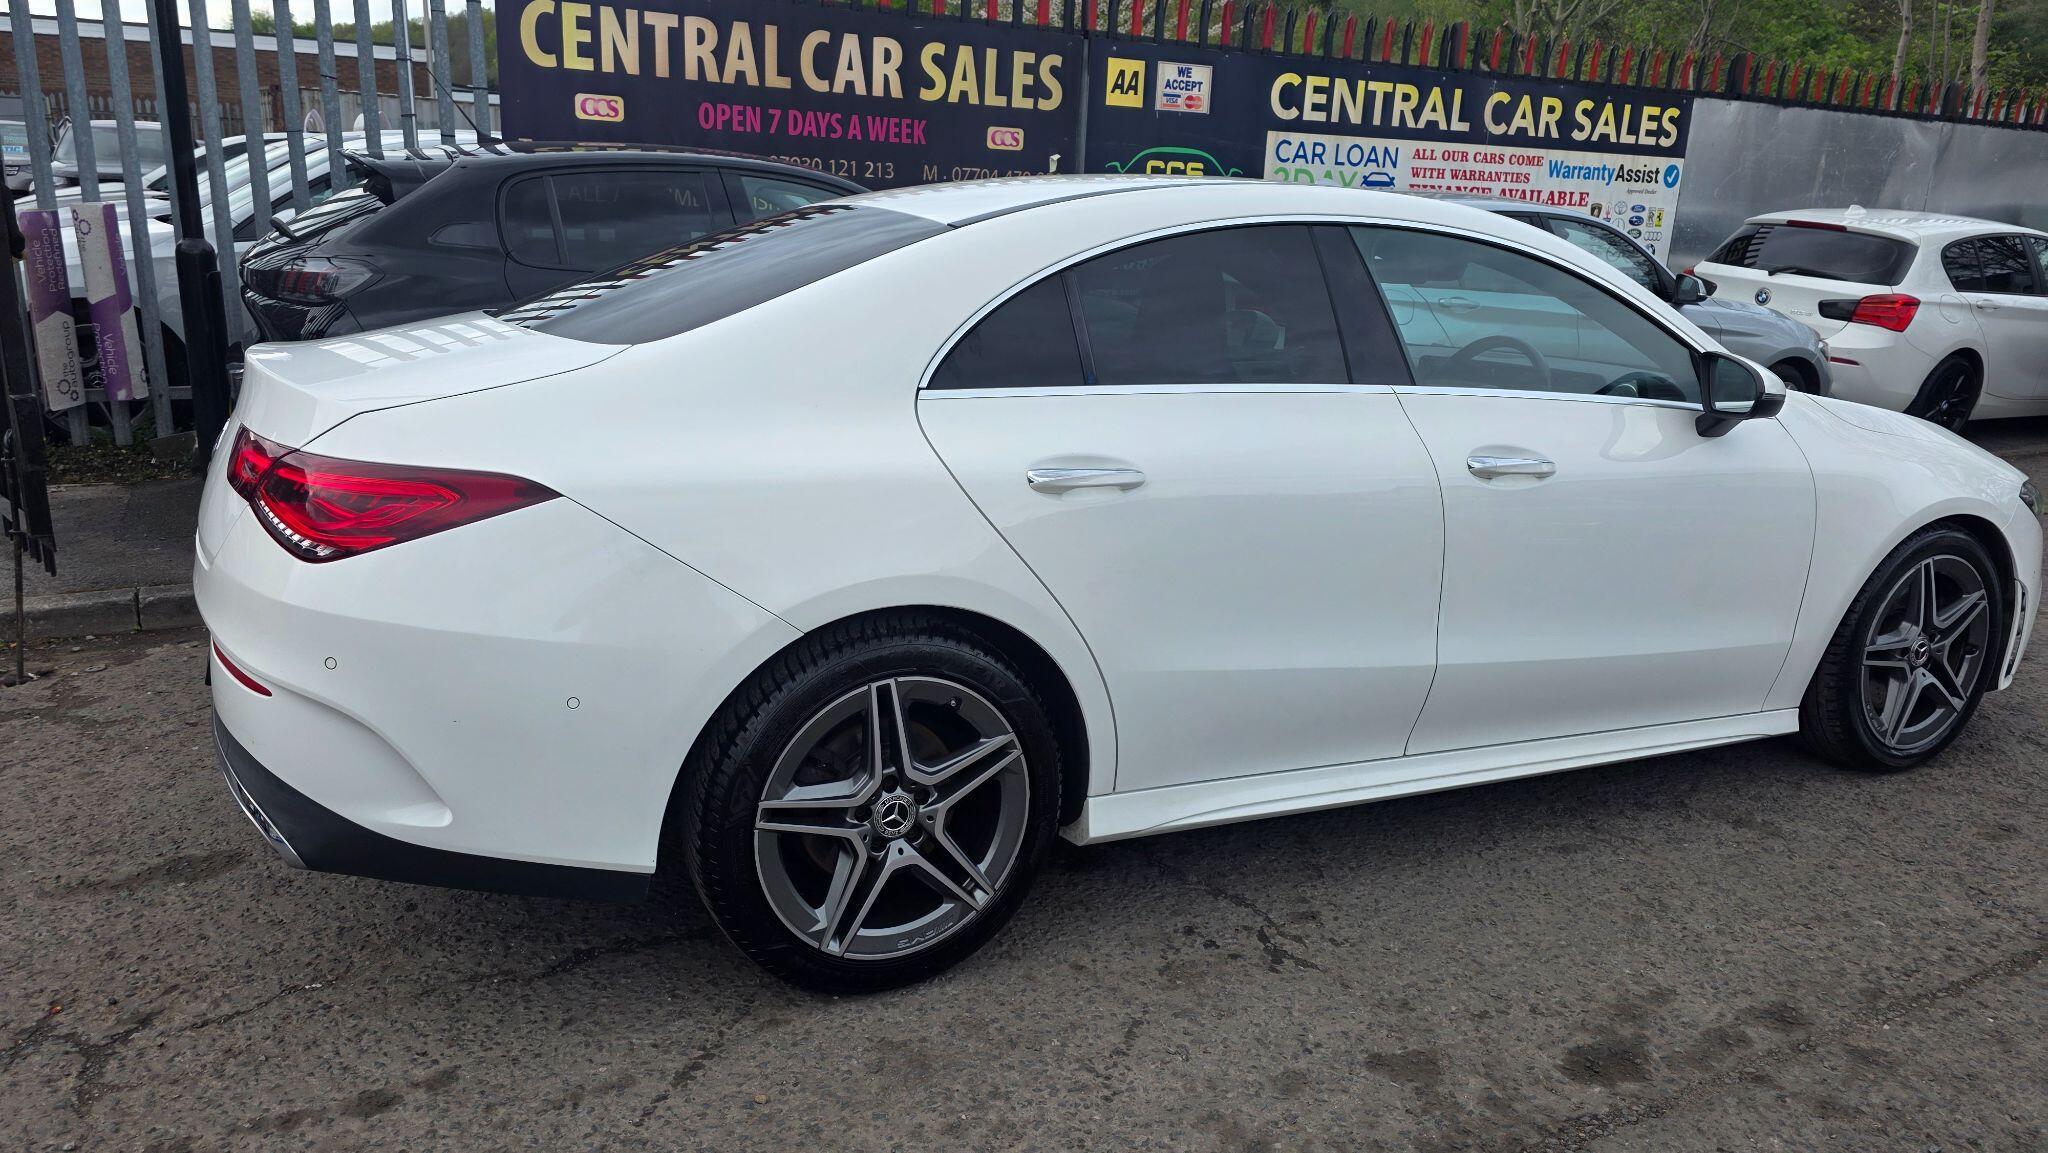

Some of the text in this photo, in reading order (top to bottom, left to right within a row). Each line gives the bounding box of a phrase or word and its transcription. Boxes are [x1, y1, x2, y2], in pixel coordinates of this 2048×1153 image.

[520, 0, 1063, 111] CENTRAL CAR SALES
[1177, 66, 1193, 79] WE
[1110, 68, 1140, 96] AA
[1164, 79, 1204, 93] ACCEPT
[698, 102, 928, 145] OPEN 7 DAYS A WEEK
[1270, 72, 1681, 148] CENTRAL CAR SALES
[828, 159, 857, 177] 121
[864, 161, 895, 179] 213
[1275, 139, 1400, 169] CAR LOAN
[1411, 166, 1531, 184] WITH WARRANTIES
[1412, 148, 1544, 167] ALL OUR CARS COME
[32, 239, 47, 283] Vehicle
[41, 228, 57, 292] Protection
[51, 228, 66, 291] Redefined
[62, 320, 78, 388] autogroup
[103, 333, 120, 375] Vehicle
